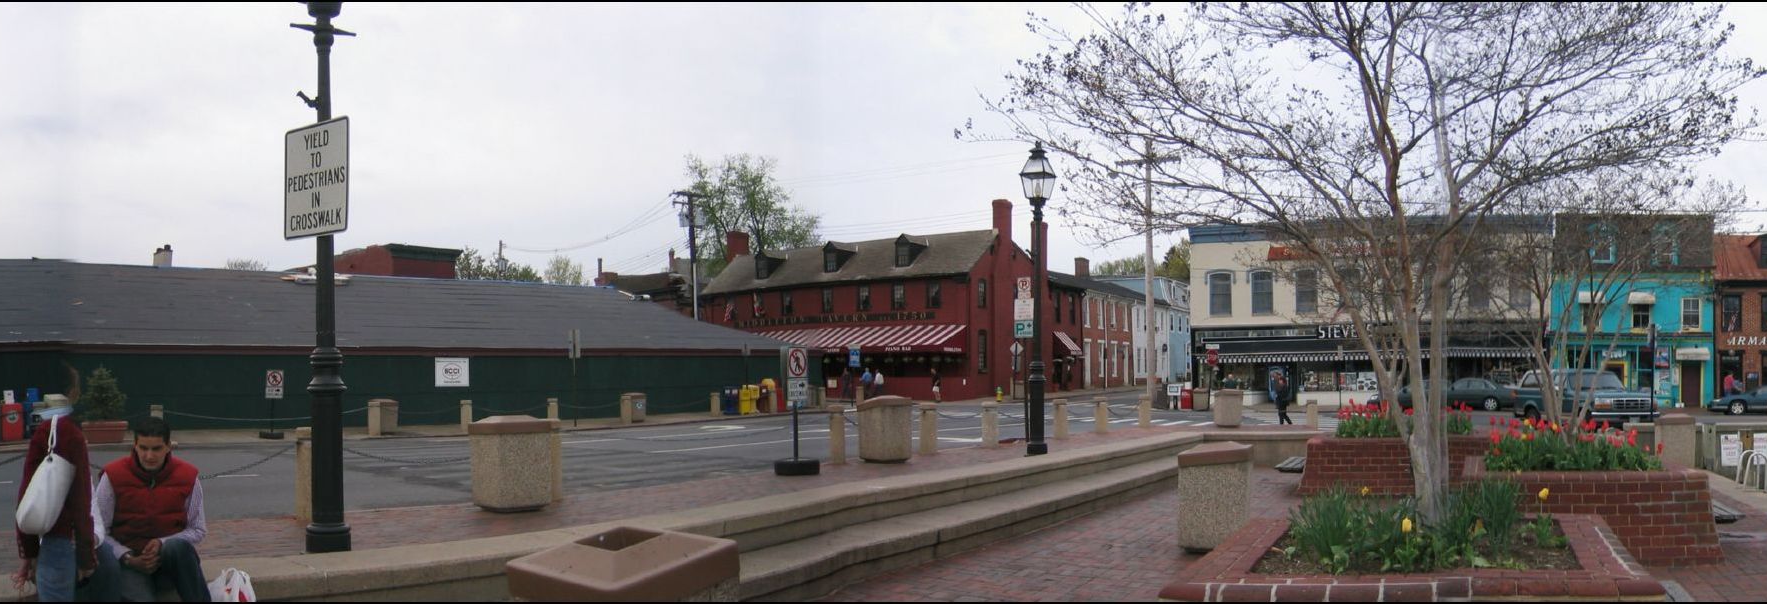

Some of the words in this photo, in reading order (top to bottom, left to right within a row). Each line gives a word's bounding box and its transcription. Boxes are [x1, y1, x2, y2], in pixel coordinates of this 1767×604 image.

[304, 129, 329, 151] YIELD
[310, 151, 322, 169] TO
[287, 166, 345, 193] PEDESTRIANS
[311, 191, 320, 208] IN
[290, 208, 342, 231] CROSSWALK
